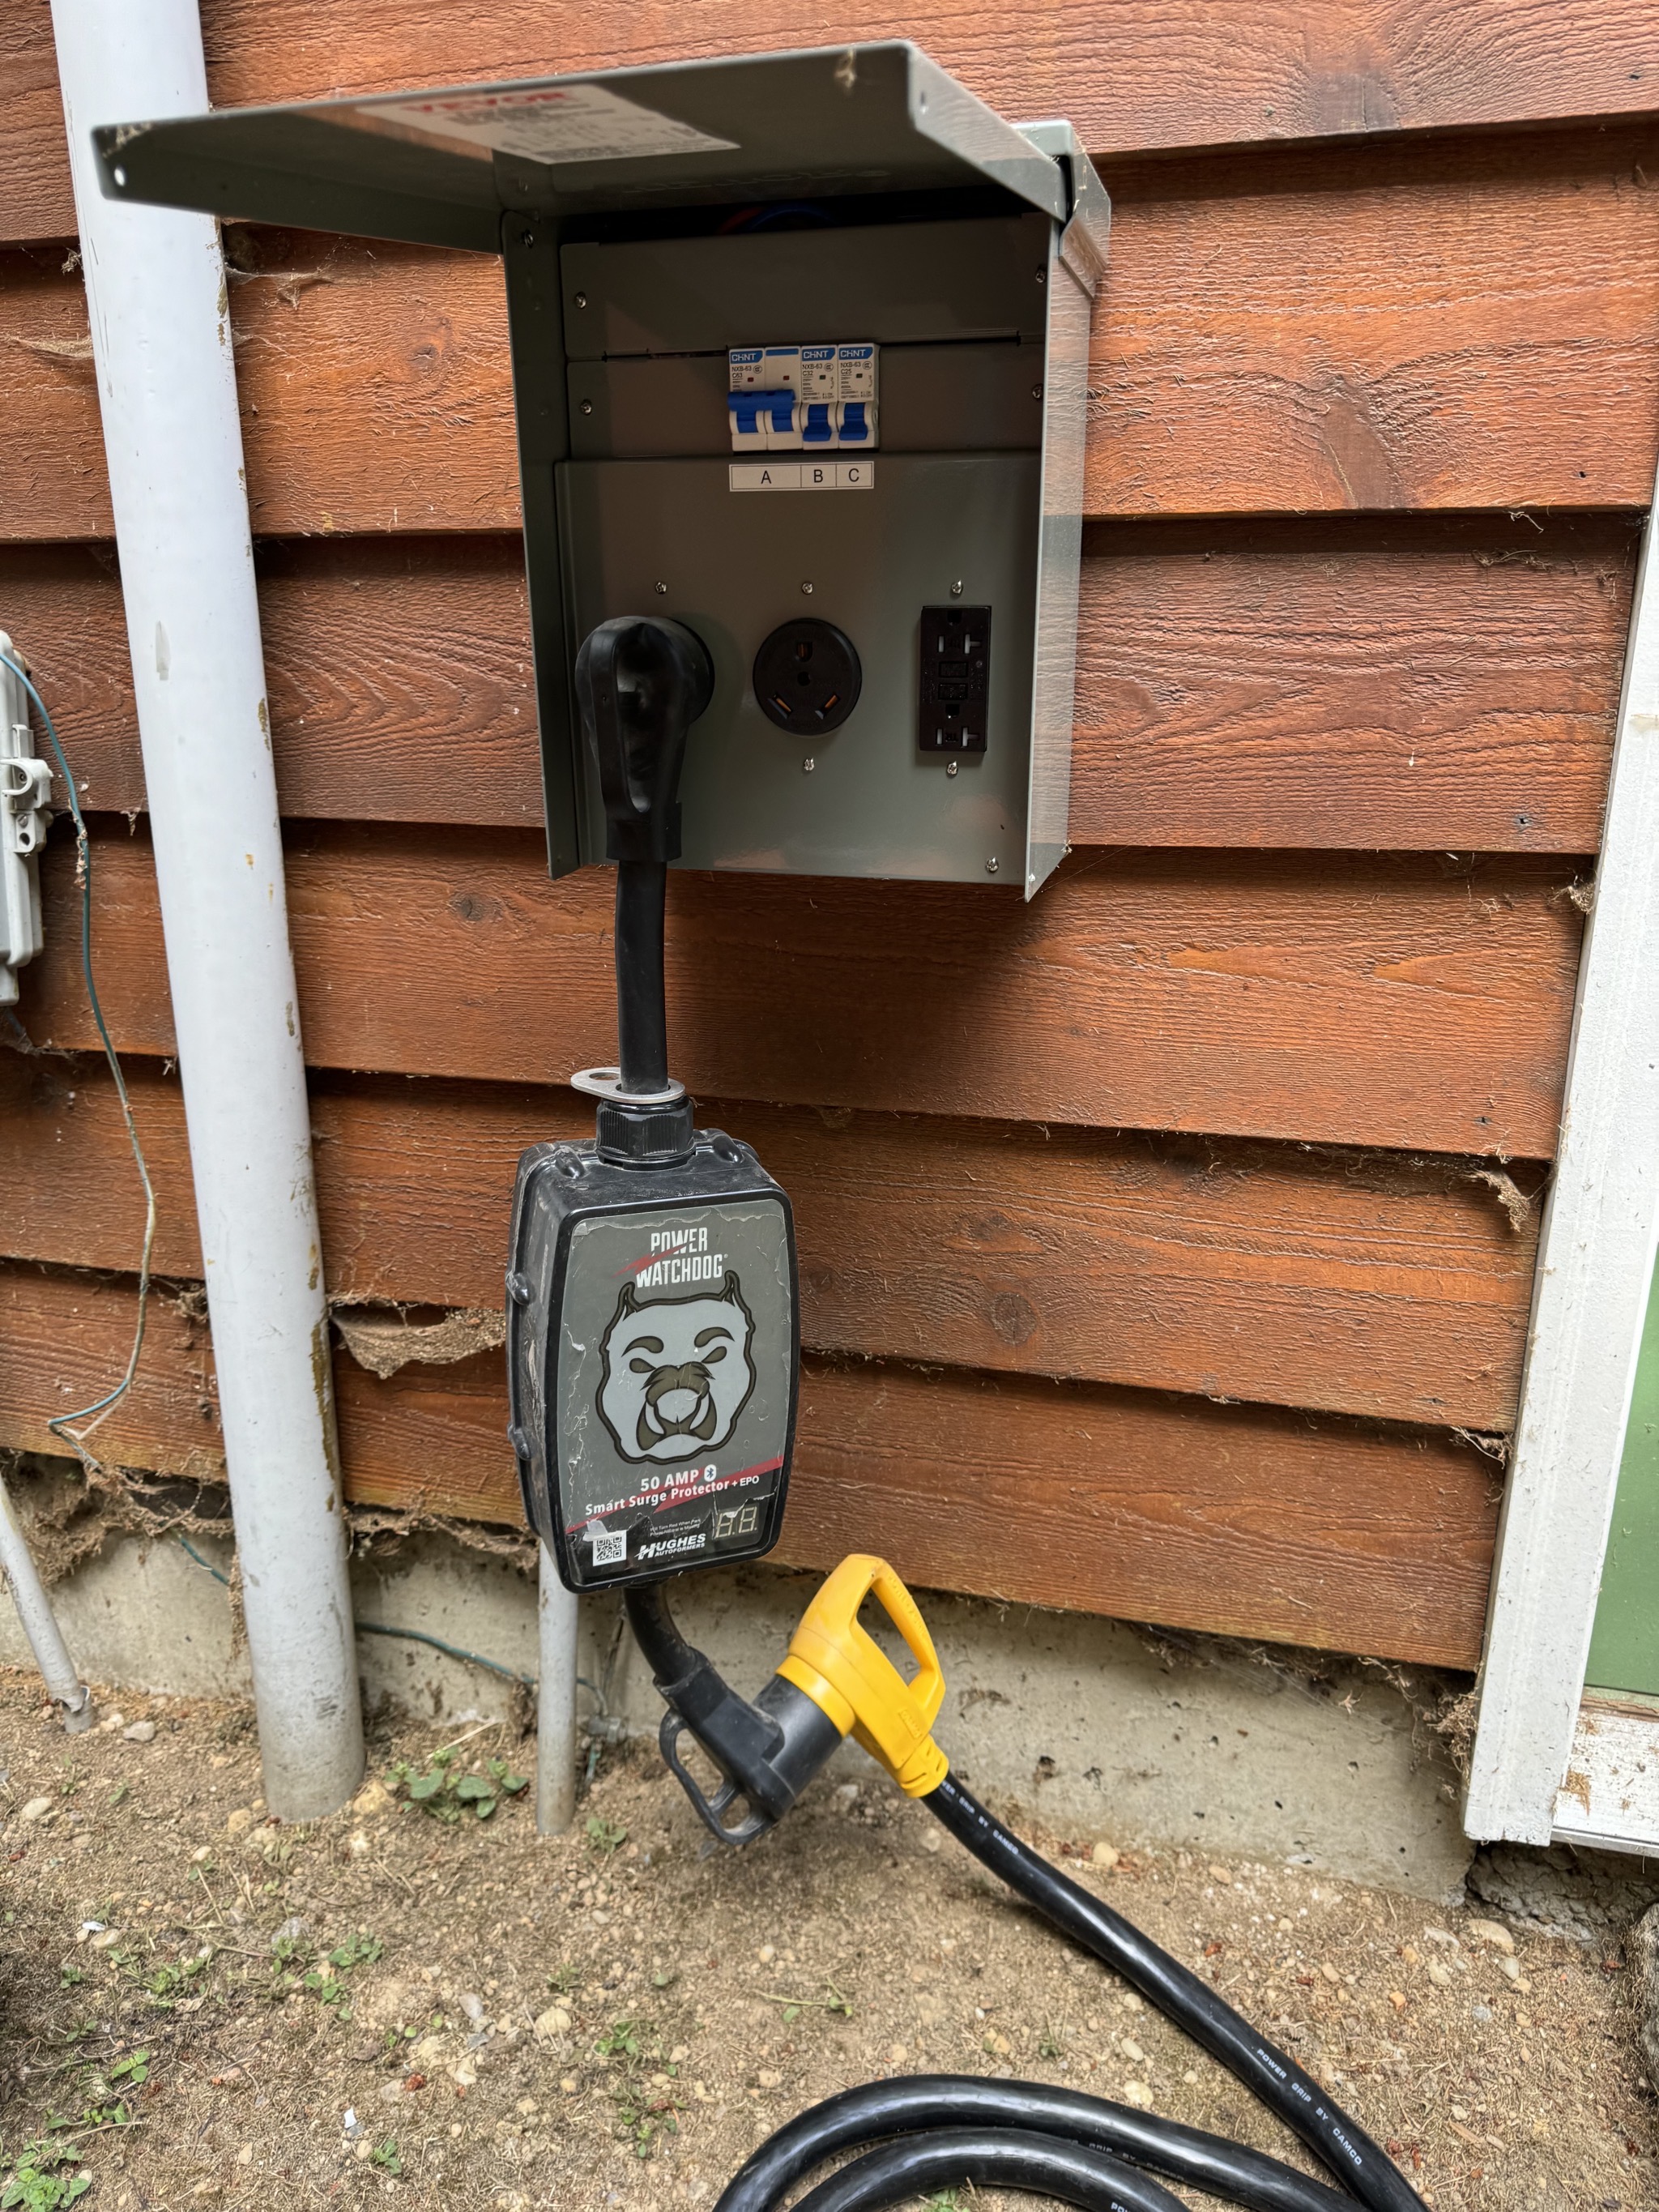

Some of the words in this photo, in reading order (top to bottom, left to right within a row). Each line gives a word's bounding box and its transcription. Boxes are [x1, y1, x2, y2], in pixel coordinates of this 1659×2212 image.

[761, 470, 772, 484] A
[813, 469, 824, 483] B
[848, 468, 859, 482] C
[650, 1228, 708, 1255] POWER
[640, 1477, 660, 1492] 50
[664, 1469, 699, 1488] AMP
[585, 1498, 625, 1516] Smart
[629, 1492, 667, 1507] Surge
[671, 1480, 730, 1500] Protector
[740, 1475, 760, 1487] EPO
[636, 1533, 706, 1561] HUGHES
[655, 1543, 706, 1557] AUTOFORMERS
[958, 1796, 975, 1814] GRIP
[978, 1815, 988, 1828] BY
[1256, 2048, 1287, 2079] POWER
[1291, 2082, 1311, 2102] GRIP
[1316, 2107, 1328, 2120] BY
[1333, 2128, 1363, 2165] CAMCO
